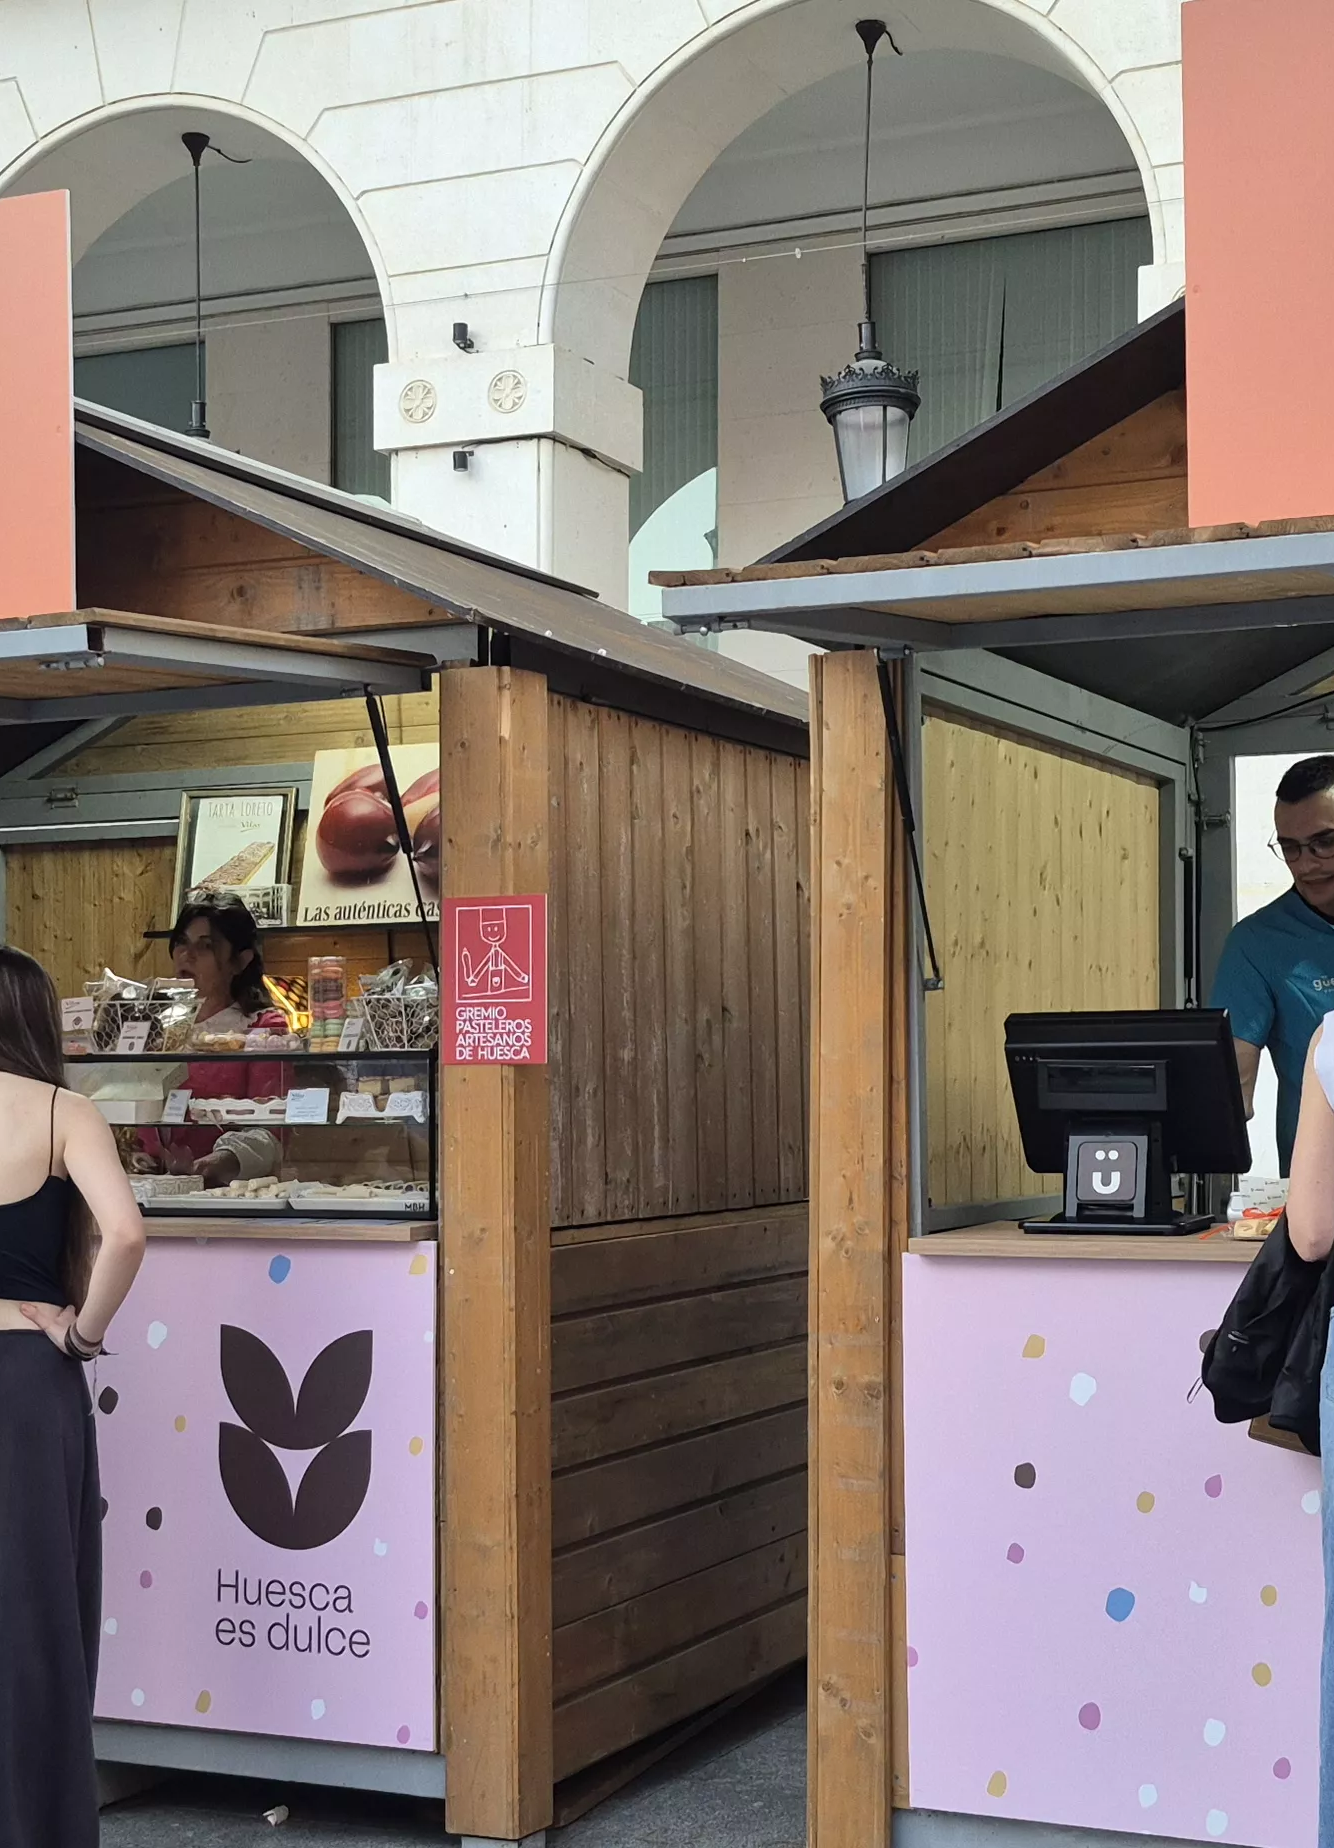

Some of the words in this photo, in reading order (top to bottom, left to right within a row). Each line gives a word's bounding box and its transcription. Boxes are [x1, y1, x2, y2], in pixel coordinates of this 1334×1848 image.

[208, 801, 235, 818] TARTA
[240, 801, 274, 817] LORETO
[303, 906, 330, 922] Las
[334, 900, 411, 921] auténticas
[456, 1006, 507, 1020] GREMIO
[456, 1019, 532, 1033] PASTELEROS
[456, 1033, 532, 1046] ARTESANOS
[456, 1047, 473, 1060] DE
[478, 1046, 530, 1060] HUESCA
[217, 1568, 354, 1614] Huesca
[215, 1617, 256, 1648] es
[267, 1612, 371, 1659] dulce
